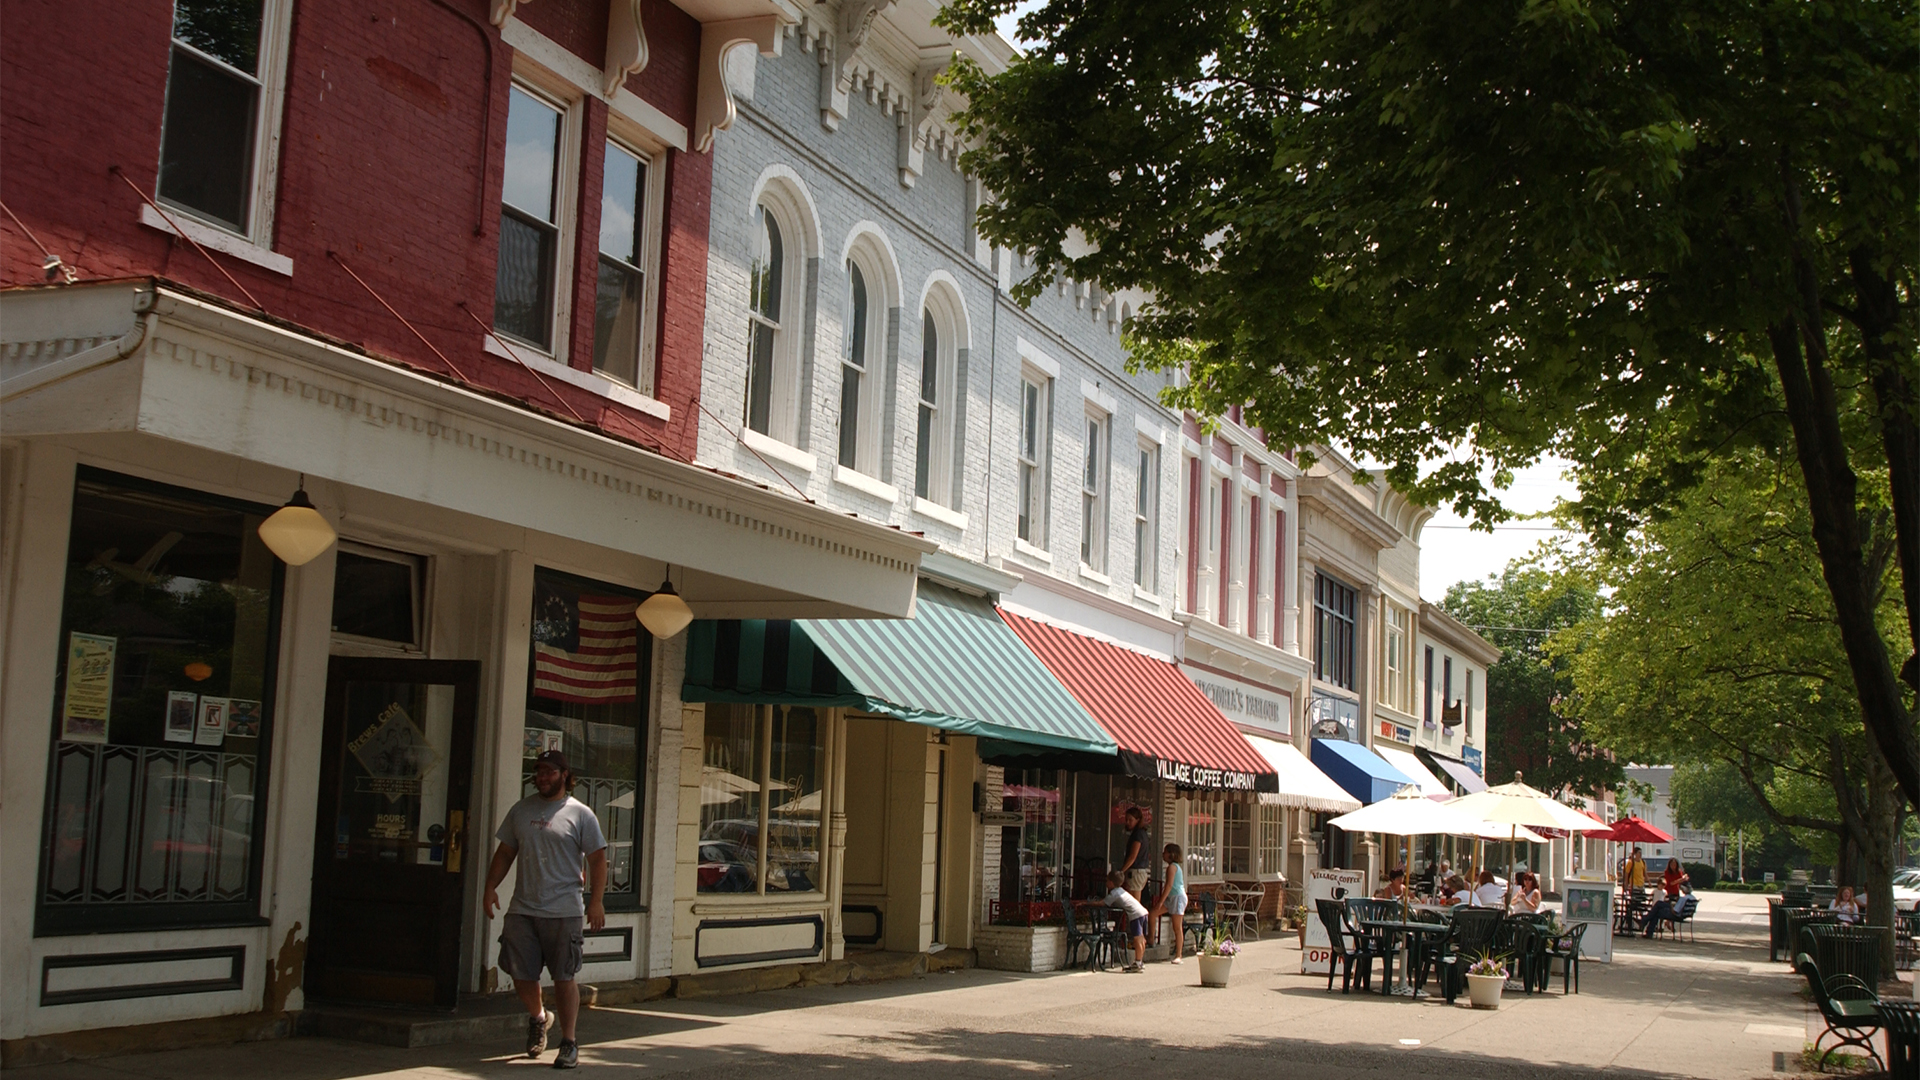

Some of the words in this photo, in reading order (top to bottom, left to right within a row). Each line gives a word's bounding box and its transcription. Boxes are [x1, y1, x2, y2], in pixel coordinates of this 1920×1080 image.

[1245, 694, 1279, 722] PARLOUR
[347, 723, 378, 753] Brews
[377, 701, 400, 723] Cafe
[1156, 759, 1191, 784] VILLAGE
[1193, 768, 1222, 788] COFFEE
[1224, 770, 1257, 790] COMPANY
[377, 813, 406, 824] HOURS
[1312, 873, 1338, 882] VILLAGE
[1339, 875, 1362, 884] COFFEE
[1310, 951, 1345, 964] OPN
